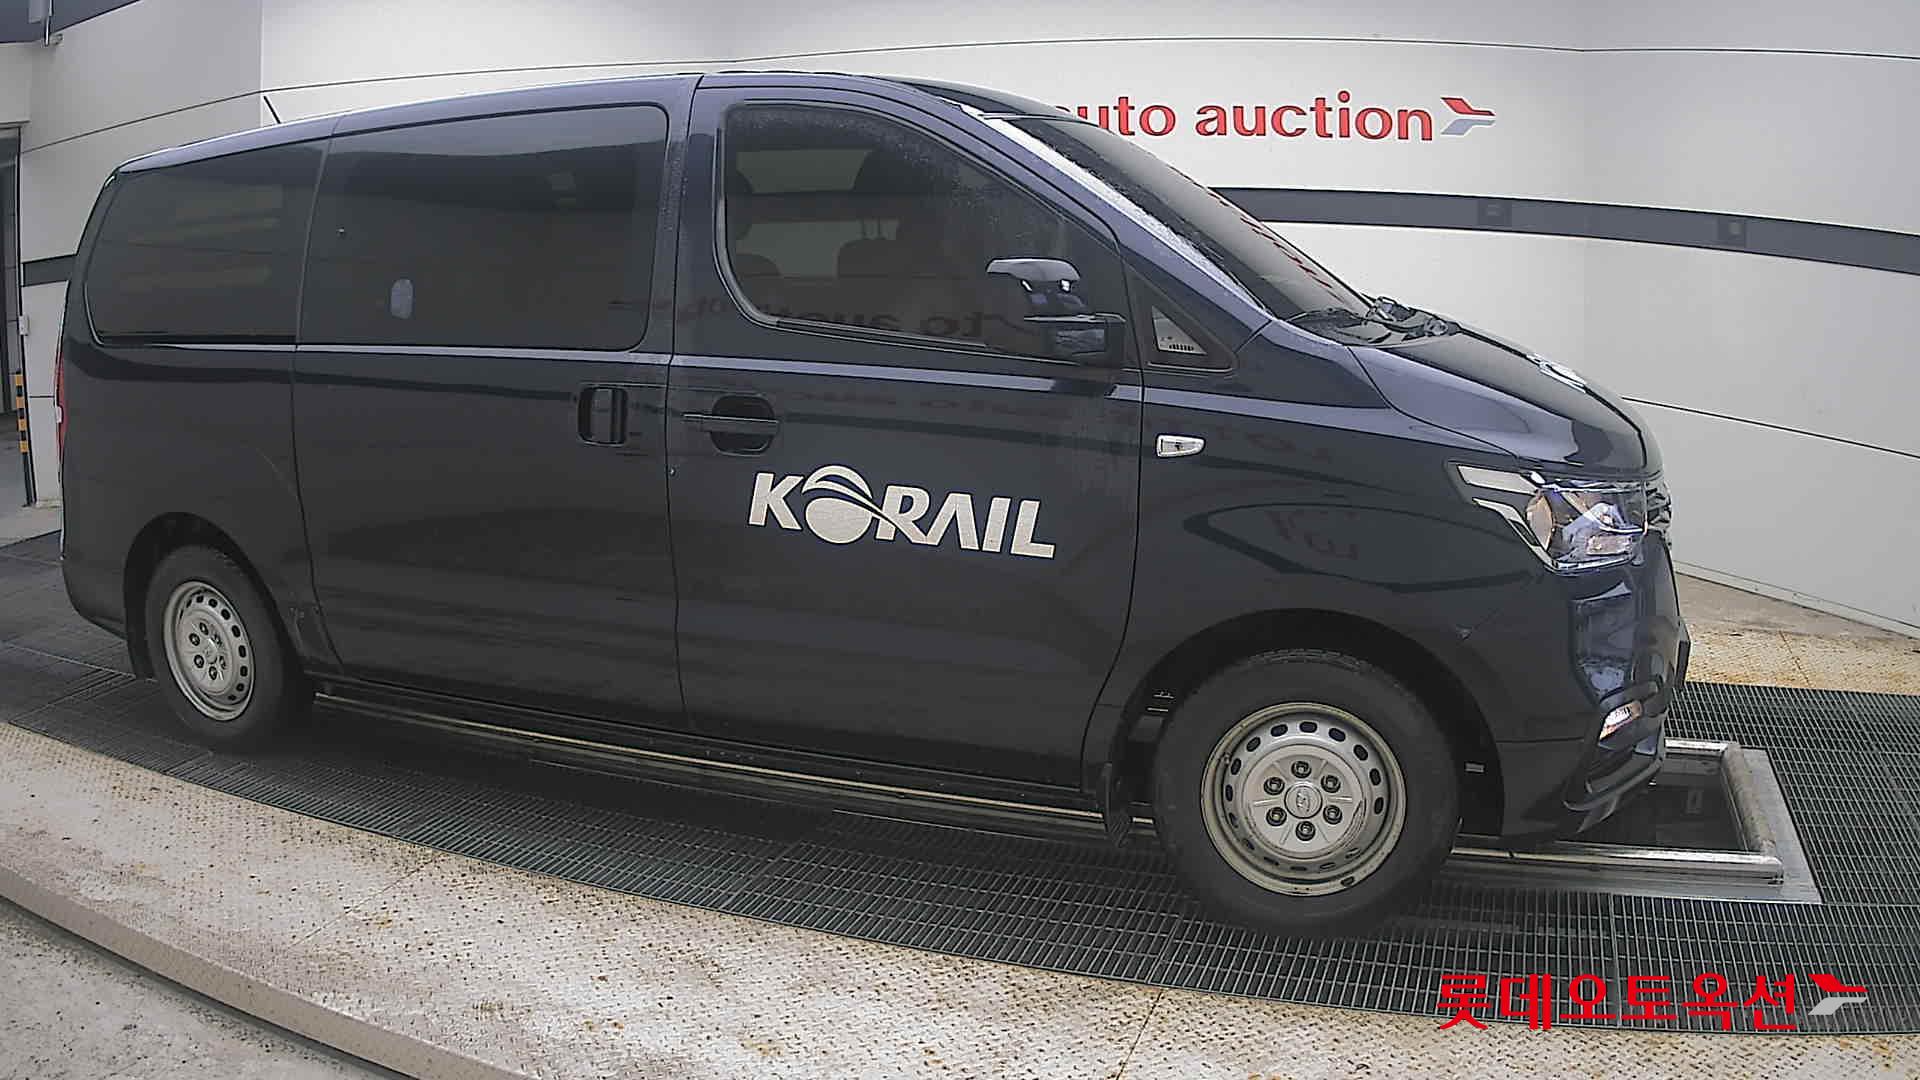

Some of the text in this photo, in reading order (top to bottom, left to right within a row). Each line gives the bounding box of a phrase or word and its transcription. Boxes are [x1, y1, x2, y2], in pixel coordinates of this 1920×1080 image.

[1056, 89, 1433, 141] uto auction
[748, 464, 1056, 559] KORAIL
